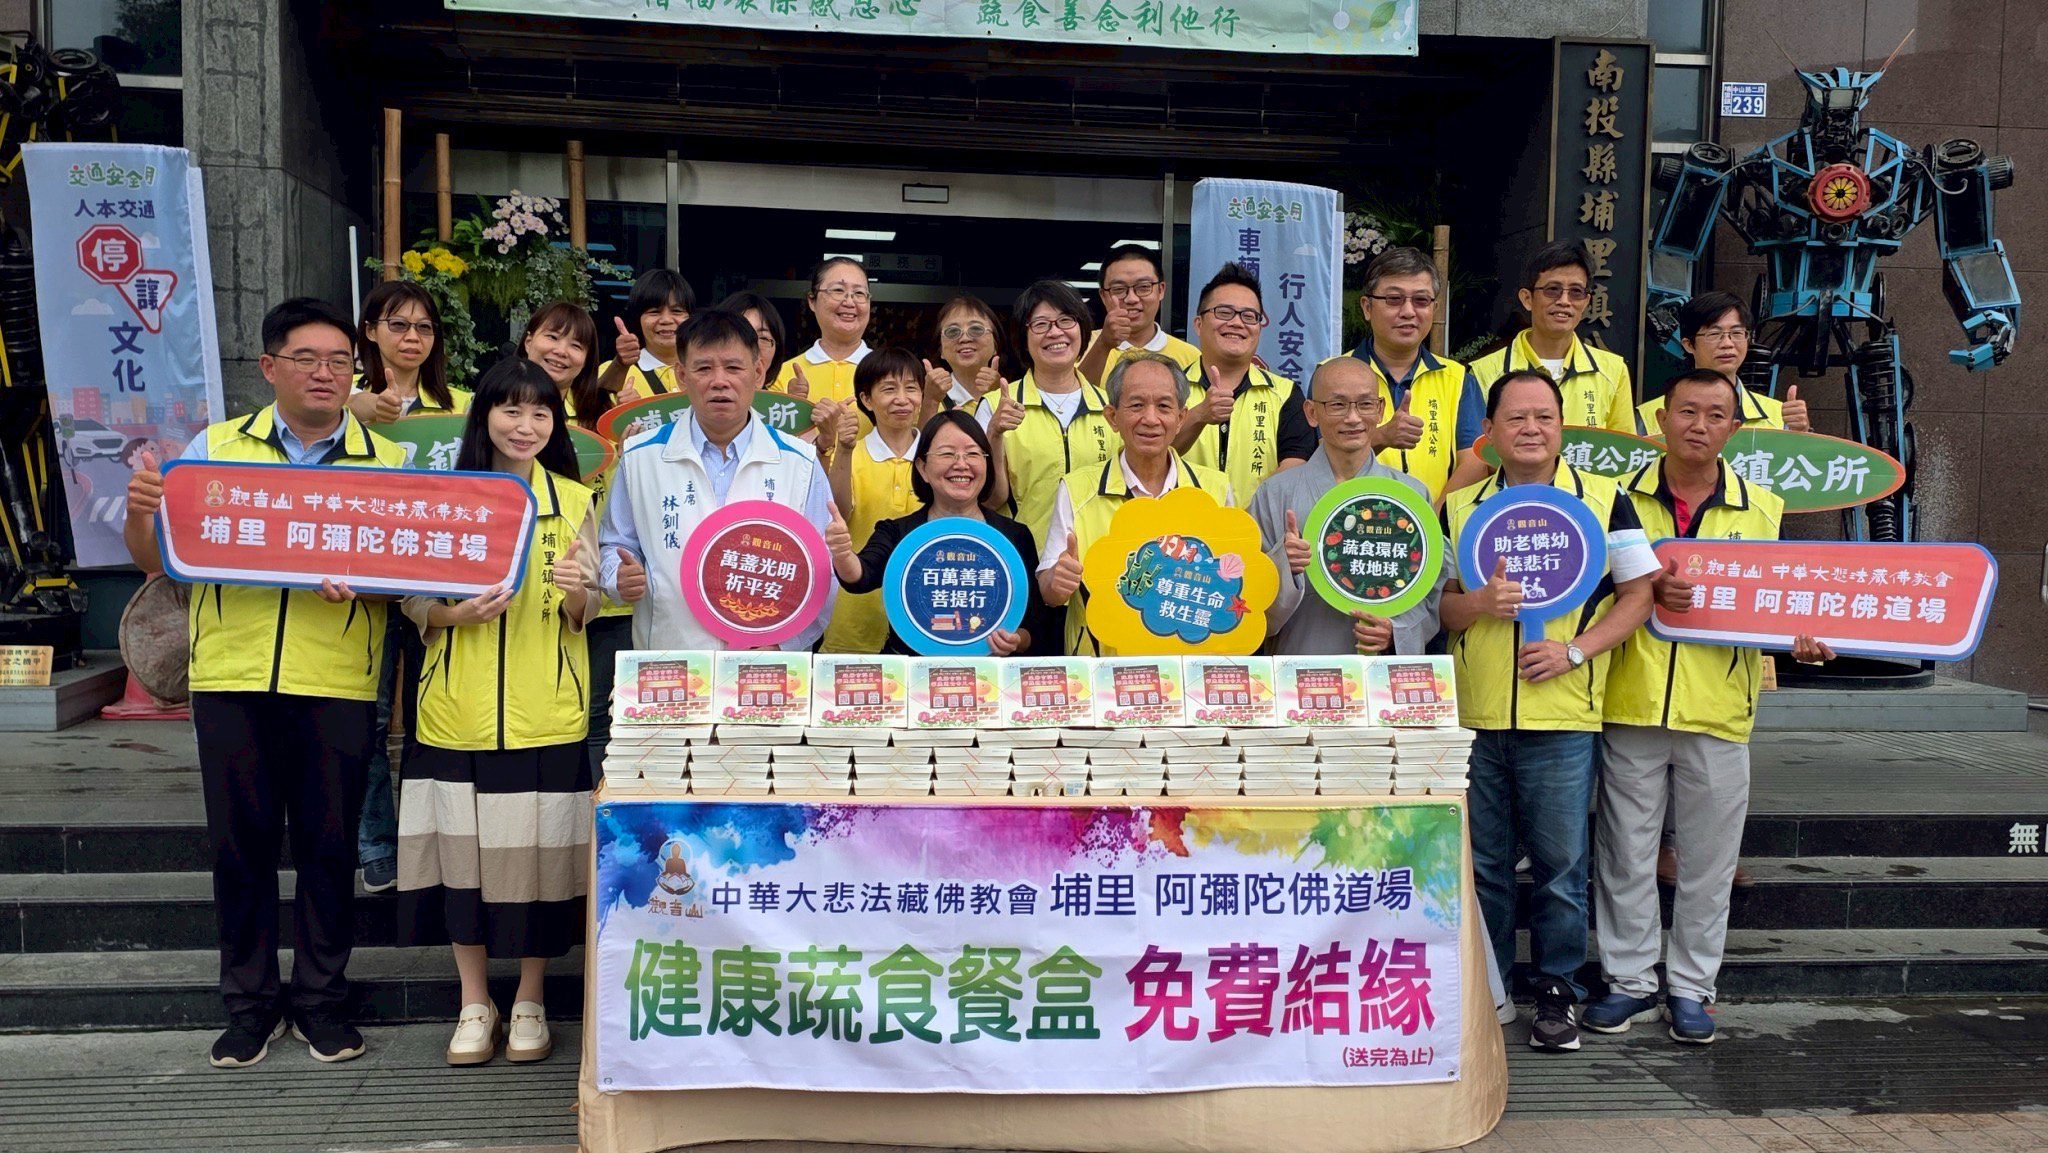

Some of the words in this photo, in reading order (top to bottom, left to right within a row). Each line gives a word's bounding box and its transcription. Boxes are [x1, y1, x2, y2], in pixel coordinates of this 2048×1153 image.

[976, 0, 1241, 38] 蔬食善念利他行
[1732, 96, 1763, 113] 239
[69, 163, 155, 188] 交通安全月
[74, 199, 155, 219] 人本交通
[1228, 197, 1303, 222] 交通安全月
[91, 238, 128, 272] 停
[134, 277, 159, 311] 讓
[1278, 273, 1306, 383] 行人安全
[108, 321, 145, 393] 文化
[1251, 401, 1267, 475] 埔里鎮公所
[1428, 399, 1439, 457] 埔里鎮公所
[1731, 448, 1871, 495] 鎮公所
[684, 481, 696, 506] 主席
[303, 492, 495, 524] 中華大悲法藏佛教會
[662, 495, 681, 549] 林釧儀
[1366, 525, 1392, 535] 觀音山
[1517, 518, 1547, 528] 觀音山
[201, 514, 266, 547] 埔里
[287, 521, 488, 562] 阿彌陀佛道場
[752, 537, 782, 552] 觀音山
[1342, 538, 1408, 559] 蔬食環保
[1494, 531, 1569, 553] 助老憐幼
[720, 549, 797, 581] 萬盞光明
[946, 552, 976, 562] 觀音山
[1349, 558, 1399, 578] 救地球
[1505, 553, 1561, 573] 慈悲行
[541, 533, 556, 625] 埔里鎮公所
[725, 573, 783, 600] 祈平安
[922, 568, 996, 587] 百萬善書
[1183, 569, 1212, 584] 觀音山
[1772, 565, 1953, 588] 中華大悲法藏佛教會
[931, 589, 987, 608] 菩提行
[1156, 577, 1225, 609] 尊重生命
[1754, 587, 1947, 624] 阿彌陀佛道場
[1159, 600, 1212, 628] 救生靈
[2008, 822, 2048, 853] 無
[712, 880, 1038, 916] 中華大悲法藏佛教會
[1050, 873, 1137, 917] 埔里
[1155, 868, 1413, 917] 阿彌陀佛道場
[624, 938, 1103, 1044] 健康蔬食餐盒
[1124, 936, 1436, 1043] 免費結緣
[1341, 1046, 1434, 1069] (送完為止)
